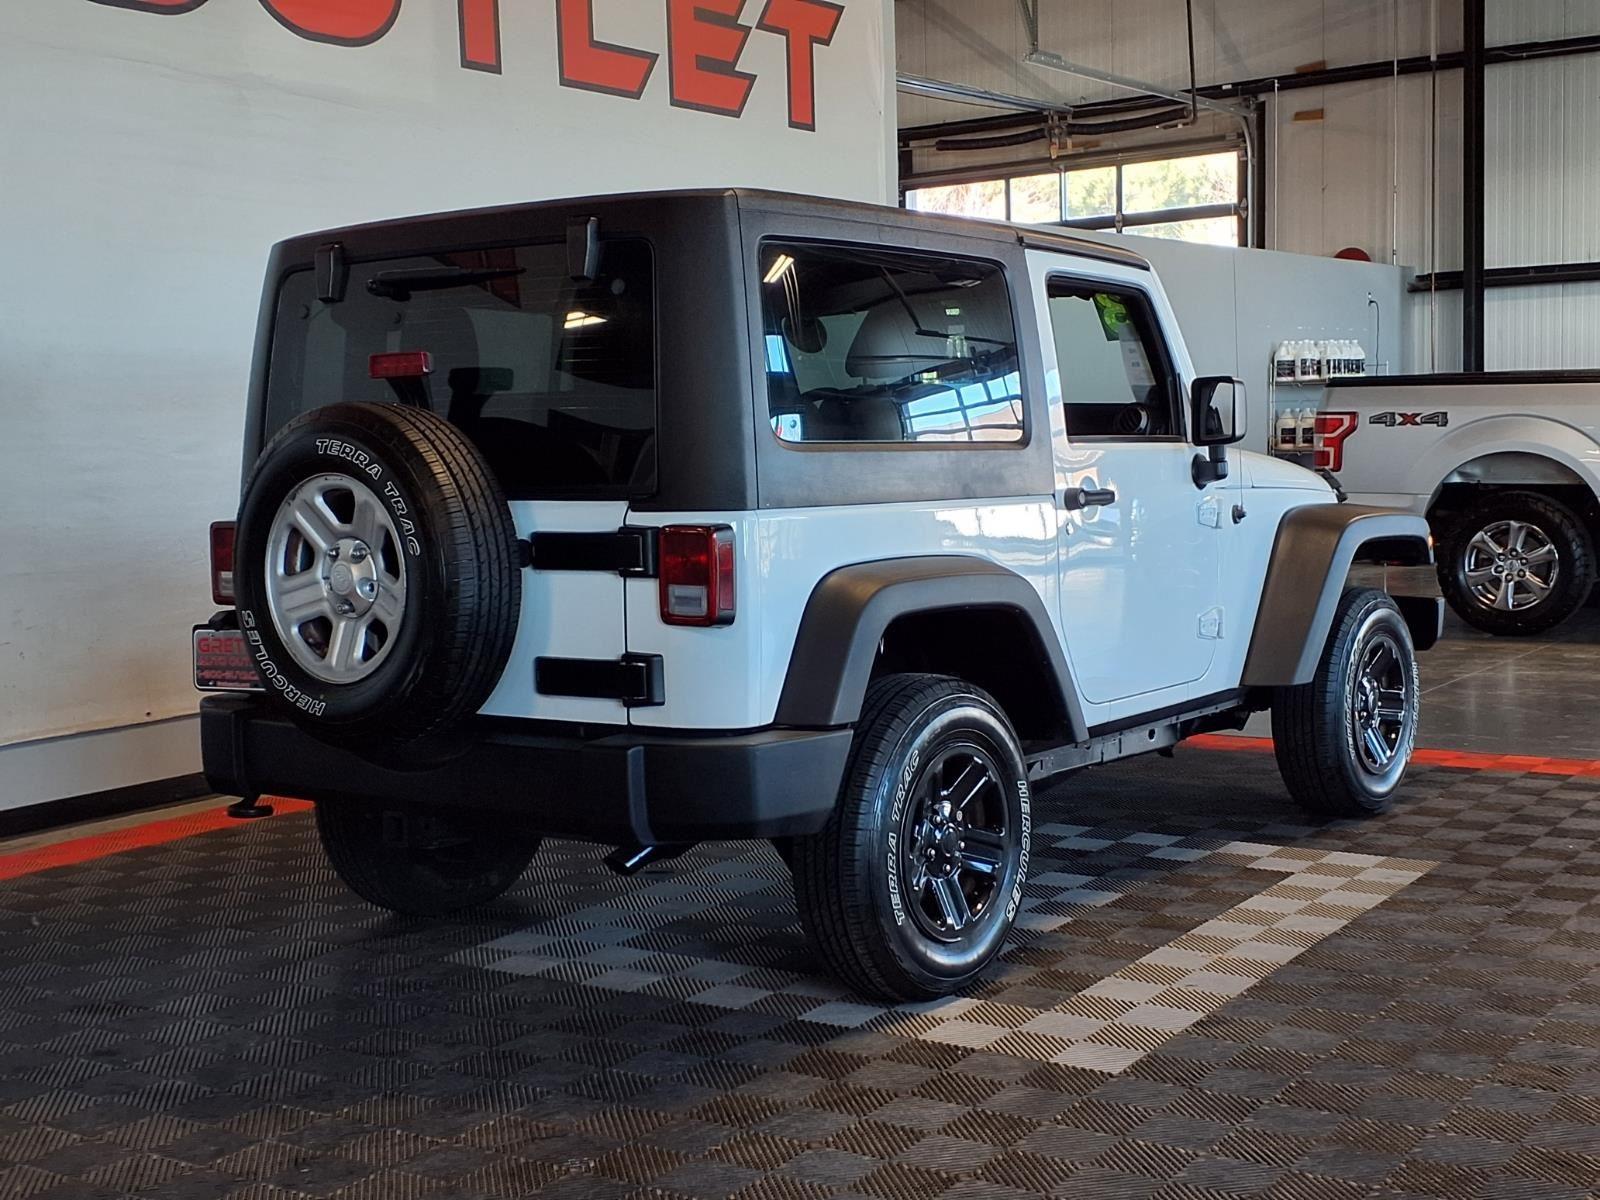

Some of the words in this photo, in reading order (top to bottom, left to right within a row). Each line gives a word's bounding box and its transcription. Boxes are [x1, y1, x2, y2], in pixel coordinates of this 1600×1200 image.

[316, 438, 382, 481] TERRA
[385, 481, 420, 556] TRAC
[241, 610, 327, 716] HERCULES
[891, 750, 920, 822] TRAC
[887, 832, 905, 926] TERRA
[1005, 780, 1033, 923] HERCULES
